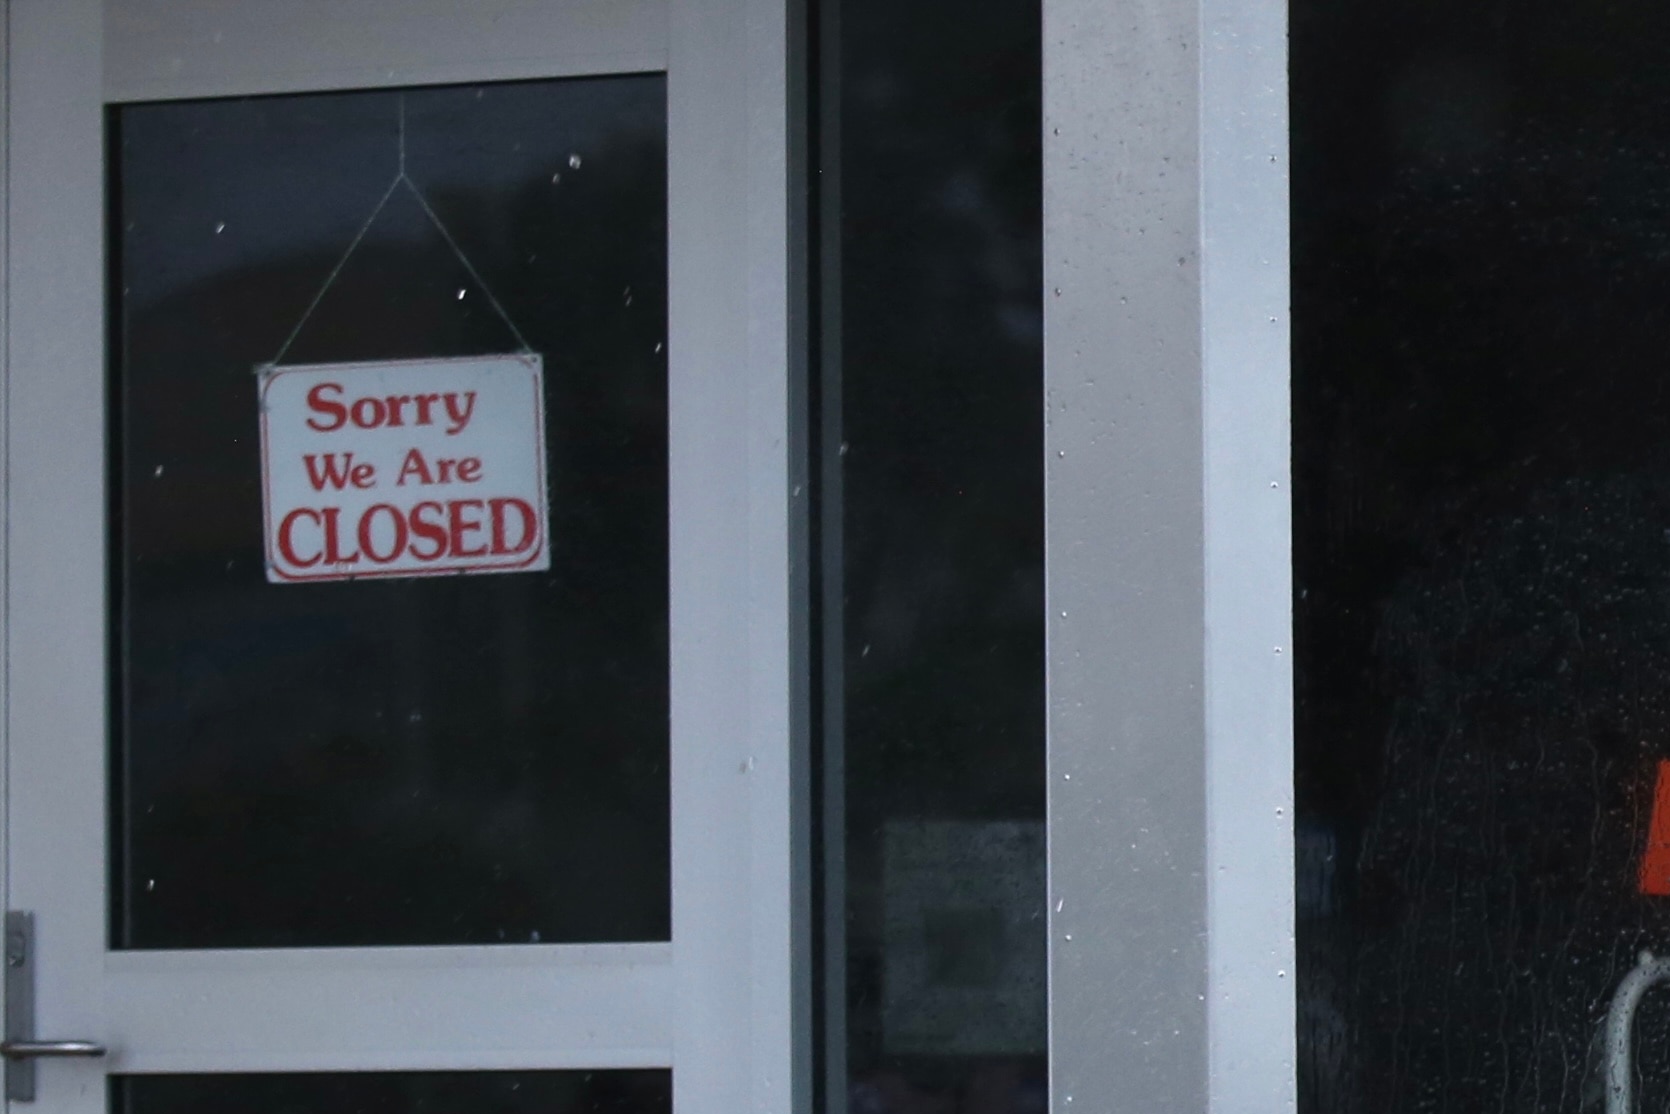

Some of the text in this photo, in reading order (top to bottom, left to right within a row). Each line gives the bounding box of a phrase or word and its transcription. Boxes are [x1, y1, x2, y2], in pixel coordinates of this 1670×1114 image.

[306, 382, 477, 435] Sorry
[302, 448, 482, 491] We Are
[276, 497, 537, 567] CLOSED
